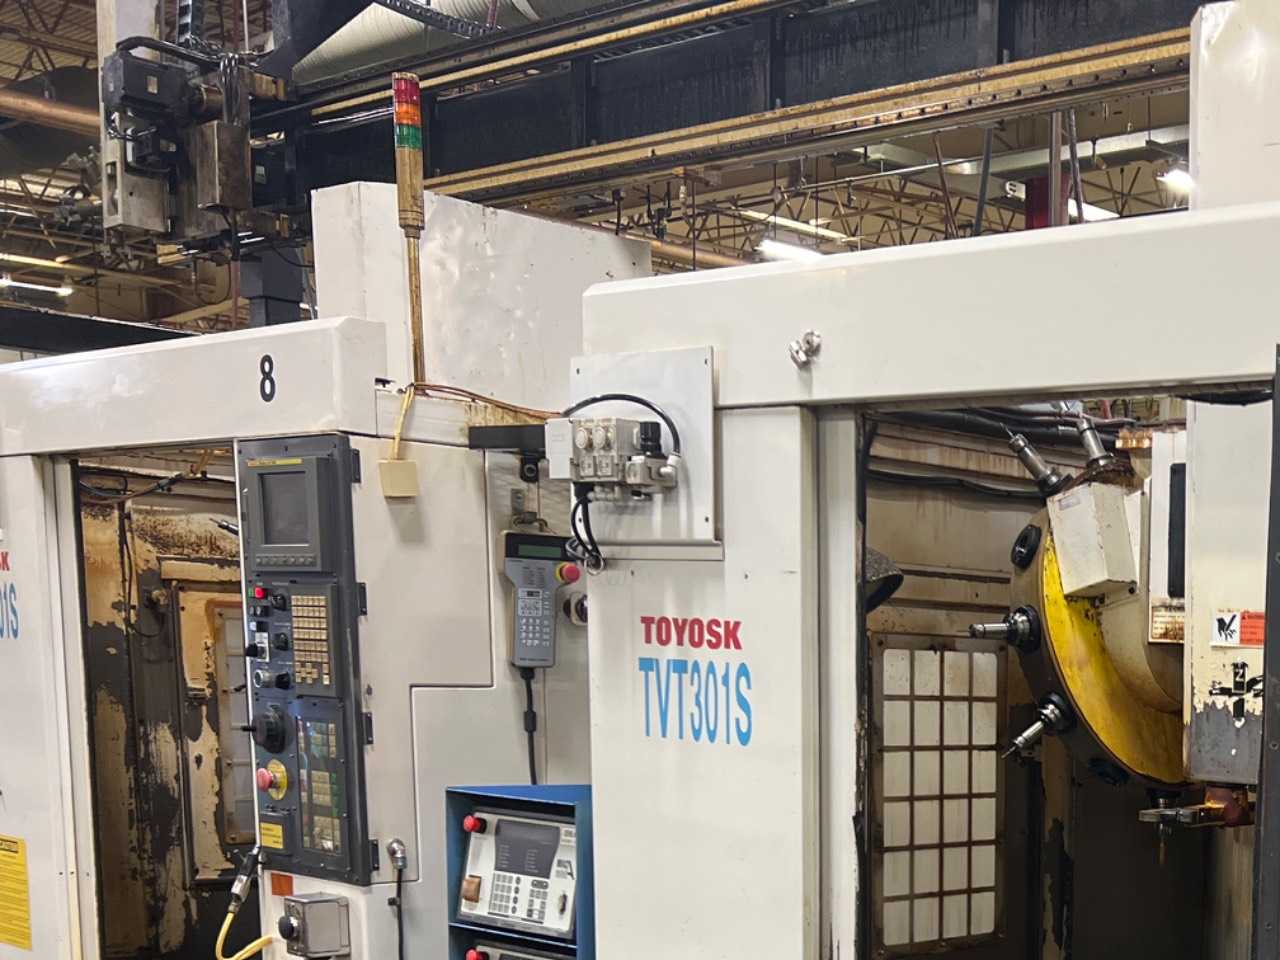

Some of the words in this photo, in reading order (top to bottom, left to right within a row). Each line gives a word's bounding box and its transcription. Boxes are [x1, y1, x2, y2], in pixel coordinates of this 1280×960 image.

[260, 354, 275, 402] 8
[641, 616, 743, 650] TOYOSK
[637, 657, 752, 746] TVT301S
